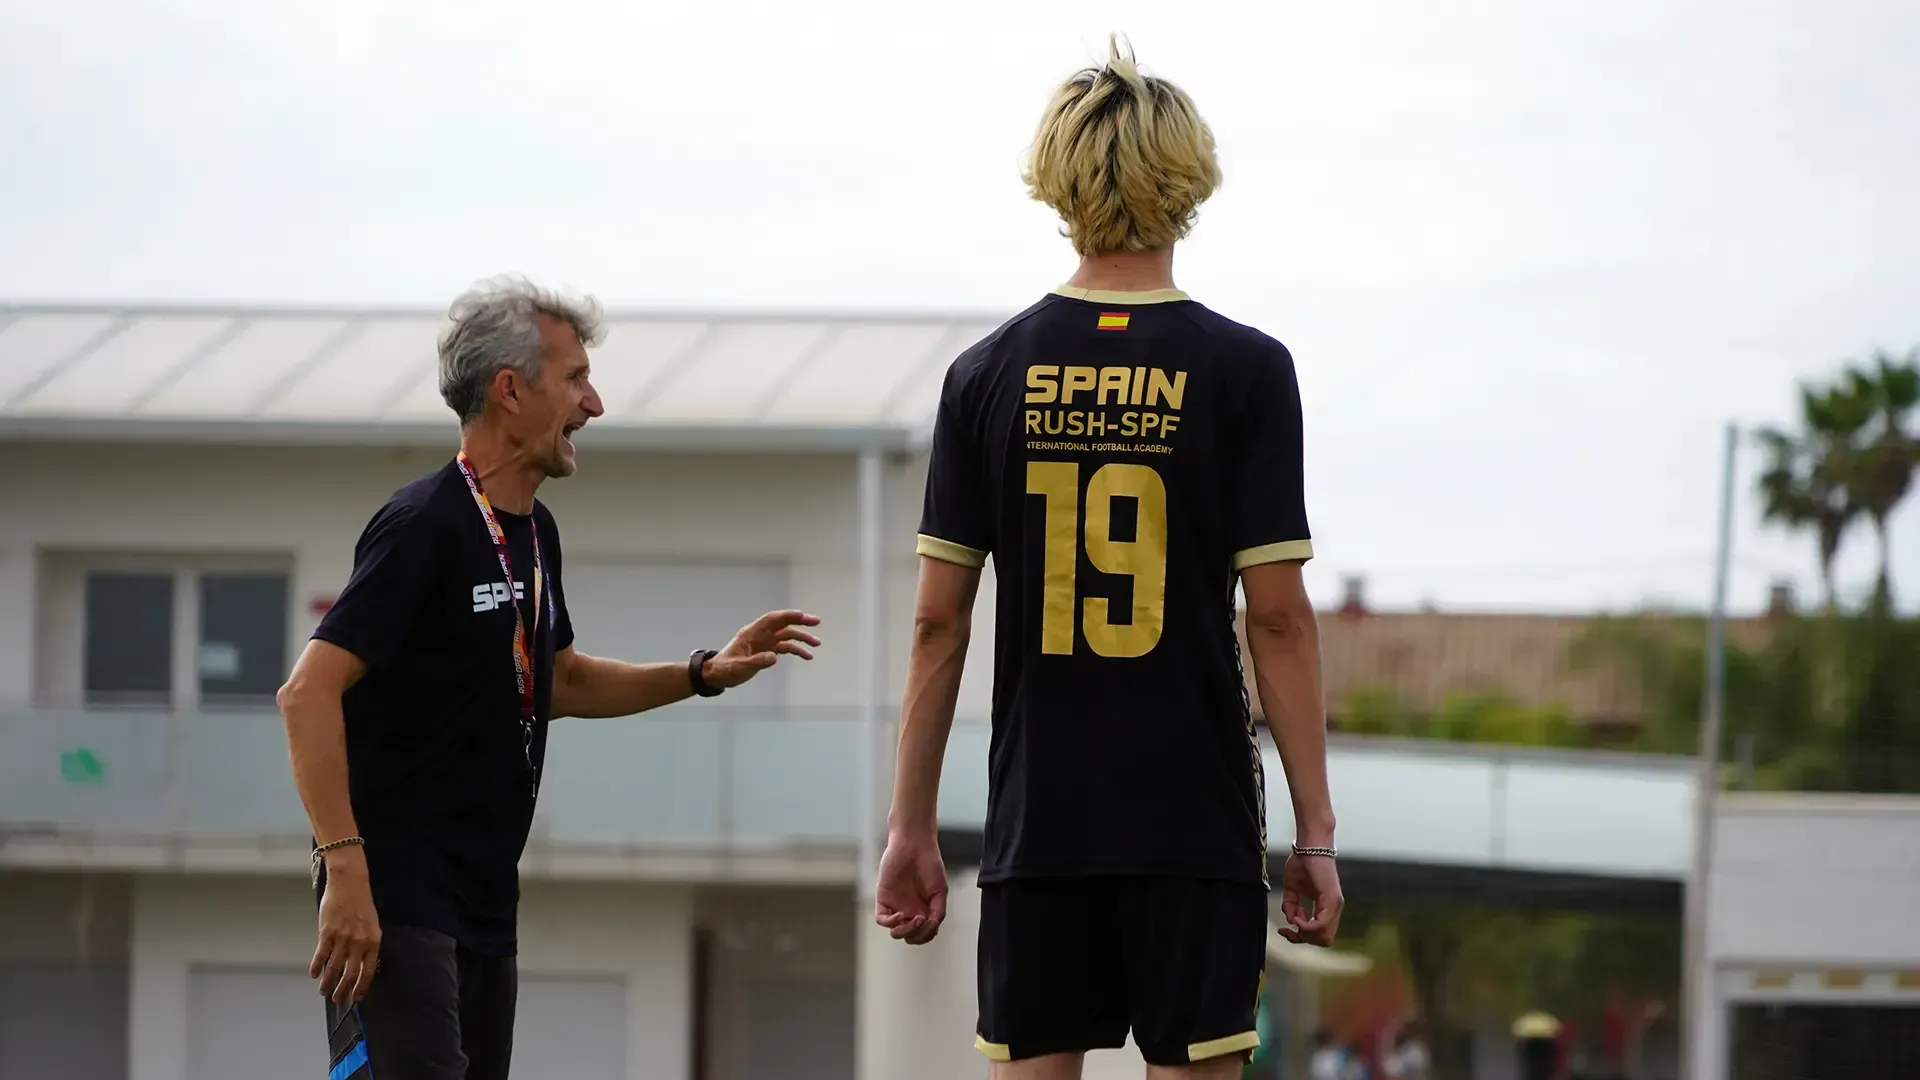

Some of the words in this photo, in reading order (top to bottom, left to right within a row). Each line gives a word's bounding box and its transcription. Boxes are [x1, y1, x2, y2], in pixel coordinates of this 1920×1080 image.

[1025, 365, 1187, 410] SPAIN
[1025, 410, 1180, 438] RUSH-SPF
[1027, 441, 1090, 451] NTERNATIONAL
[1092, 443, 1132, 452] FOOTBALL
[1133, 443, 1174, 455] ACADEMY
[1026, 461, 1168, 658] 19
[514, 651, 522, 673] OPEN
[516, 674, 525, 694] RUSH
